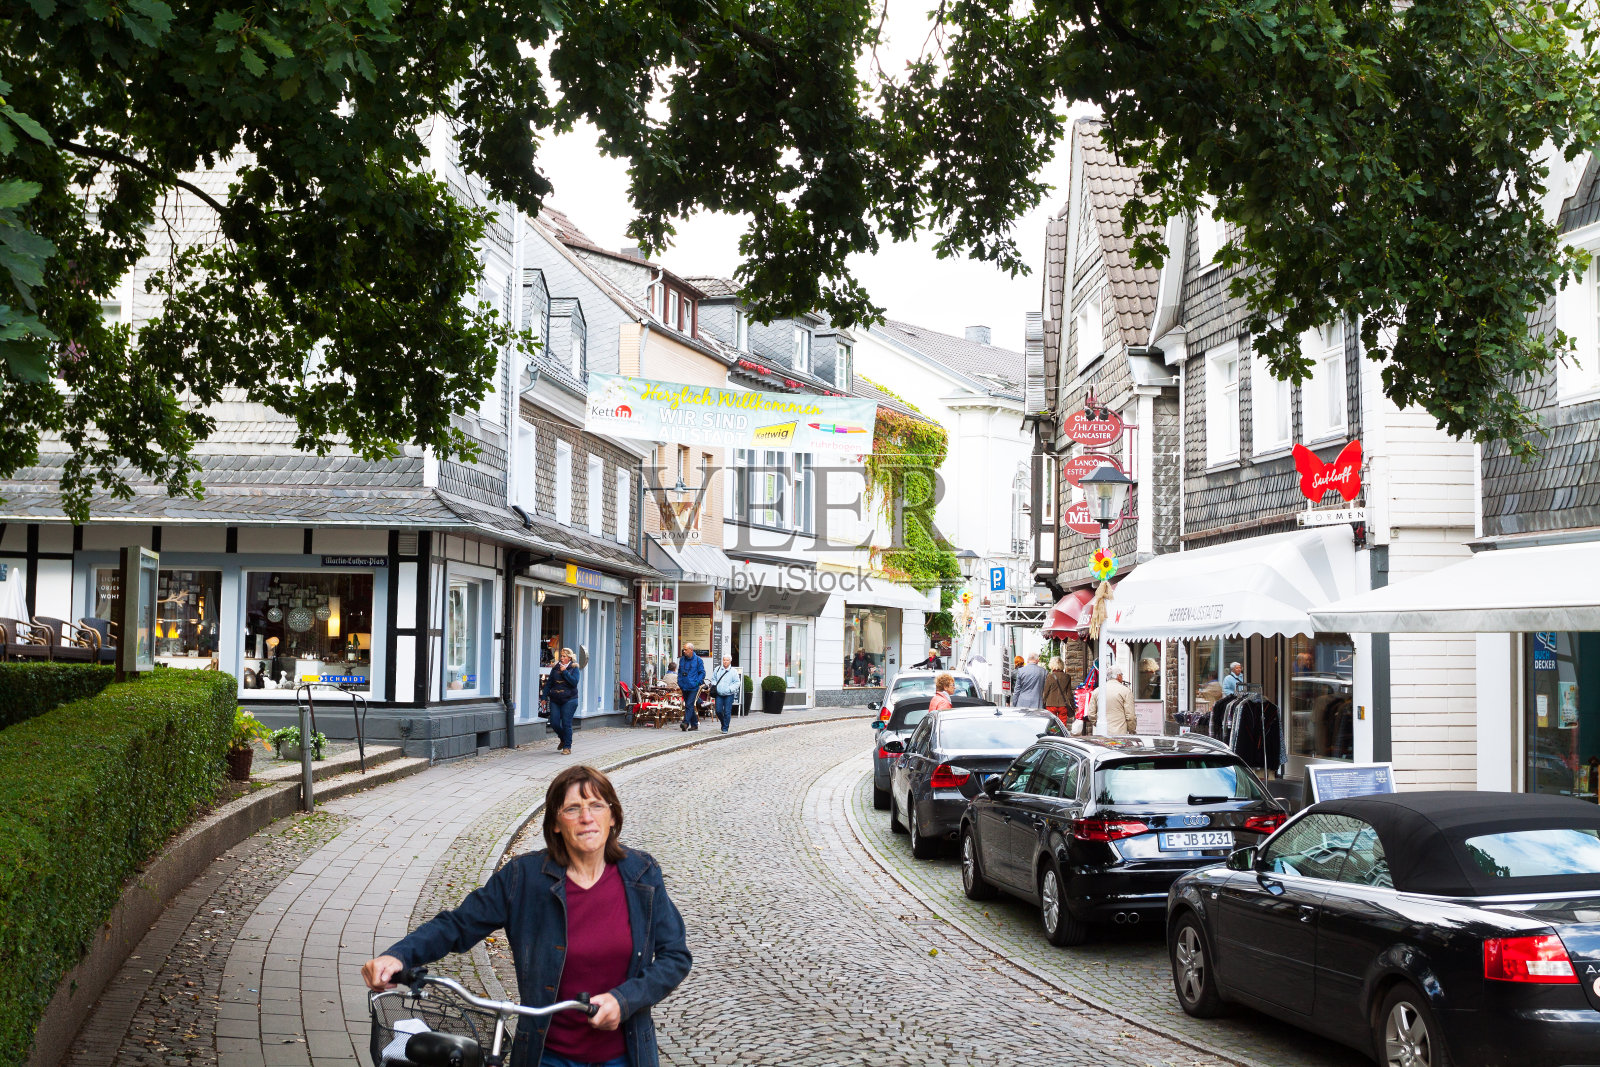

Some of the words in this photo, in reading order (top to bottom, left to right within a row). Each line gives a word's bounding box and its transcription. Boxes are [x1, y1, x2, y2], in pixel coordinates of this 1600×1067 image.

[640, 383, 715, 410] Herzlich
[718, 391, 824, 416] Willkommen
[592, 405, 631, 418] Kettin
[659, 407, 696, 426] WIR
[703, 412, 749, 431] SIND
[1070, 423, 1115, 431] SHISEIDO
[756, 429, 789, 439] Kettwig
[1312, 465, 1352, 488] Suthoff
[325, 556, 385, 566] Martin-Luther-Platz
[993, 569, 1002, 588] P
[1534, 651, 1550, 659] BUCH
[1534, 660, 1556, 669] DECKER
[1167, 834, 1175, 846] E
[1183, 834, 1199, 846] JB
[1201, 833, 1231, 845] 1231
